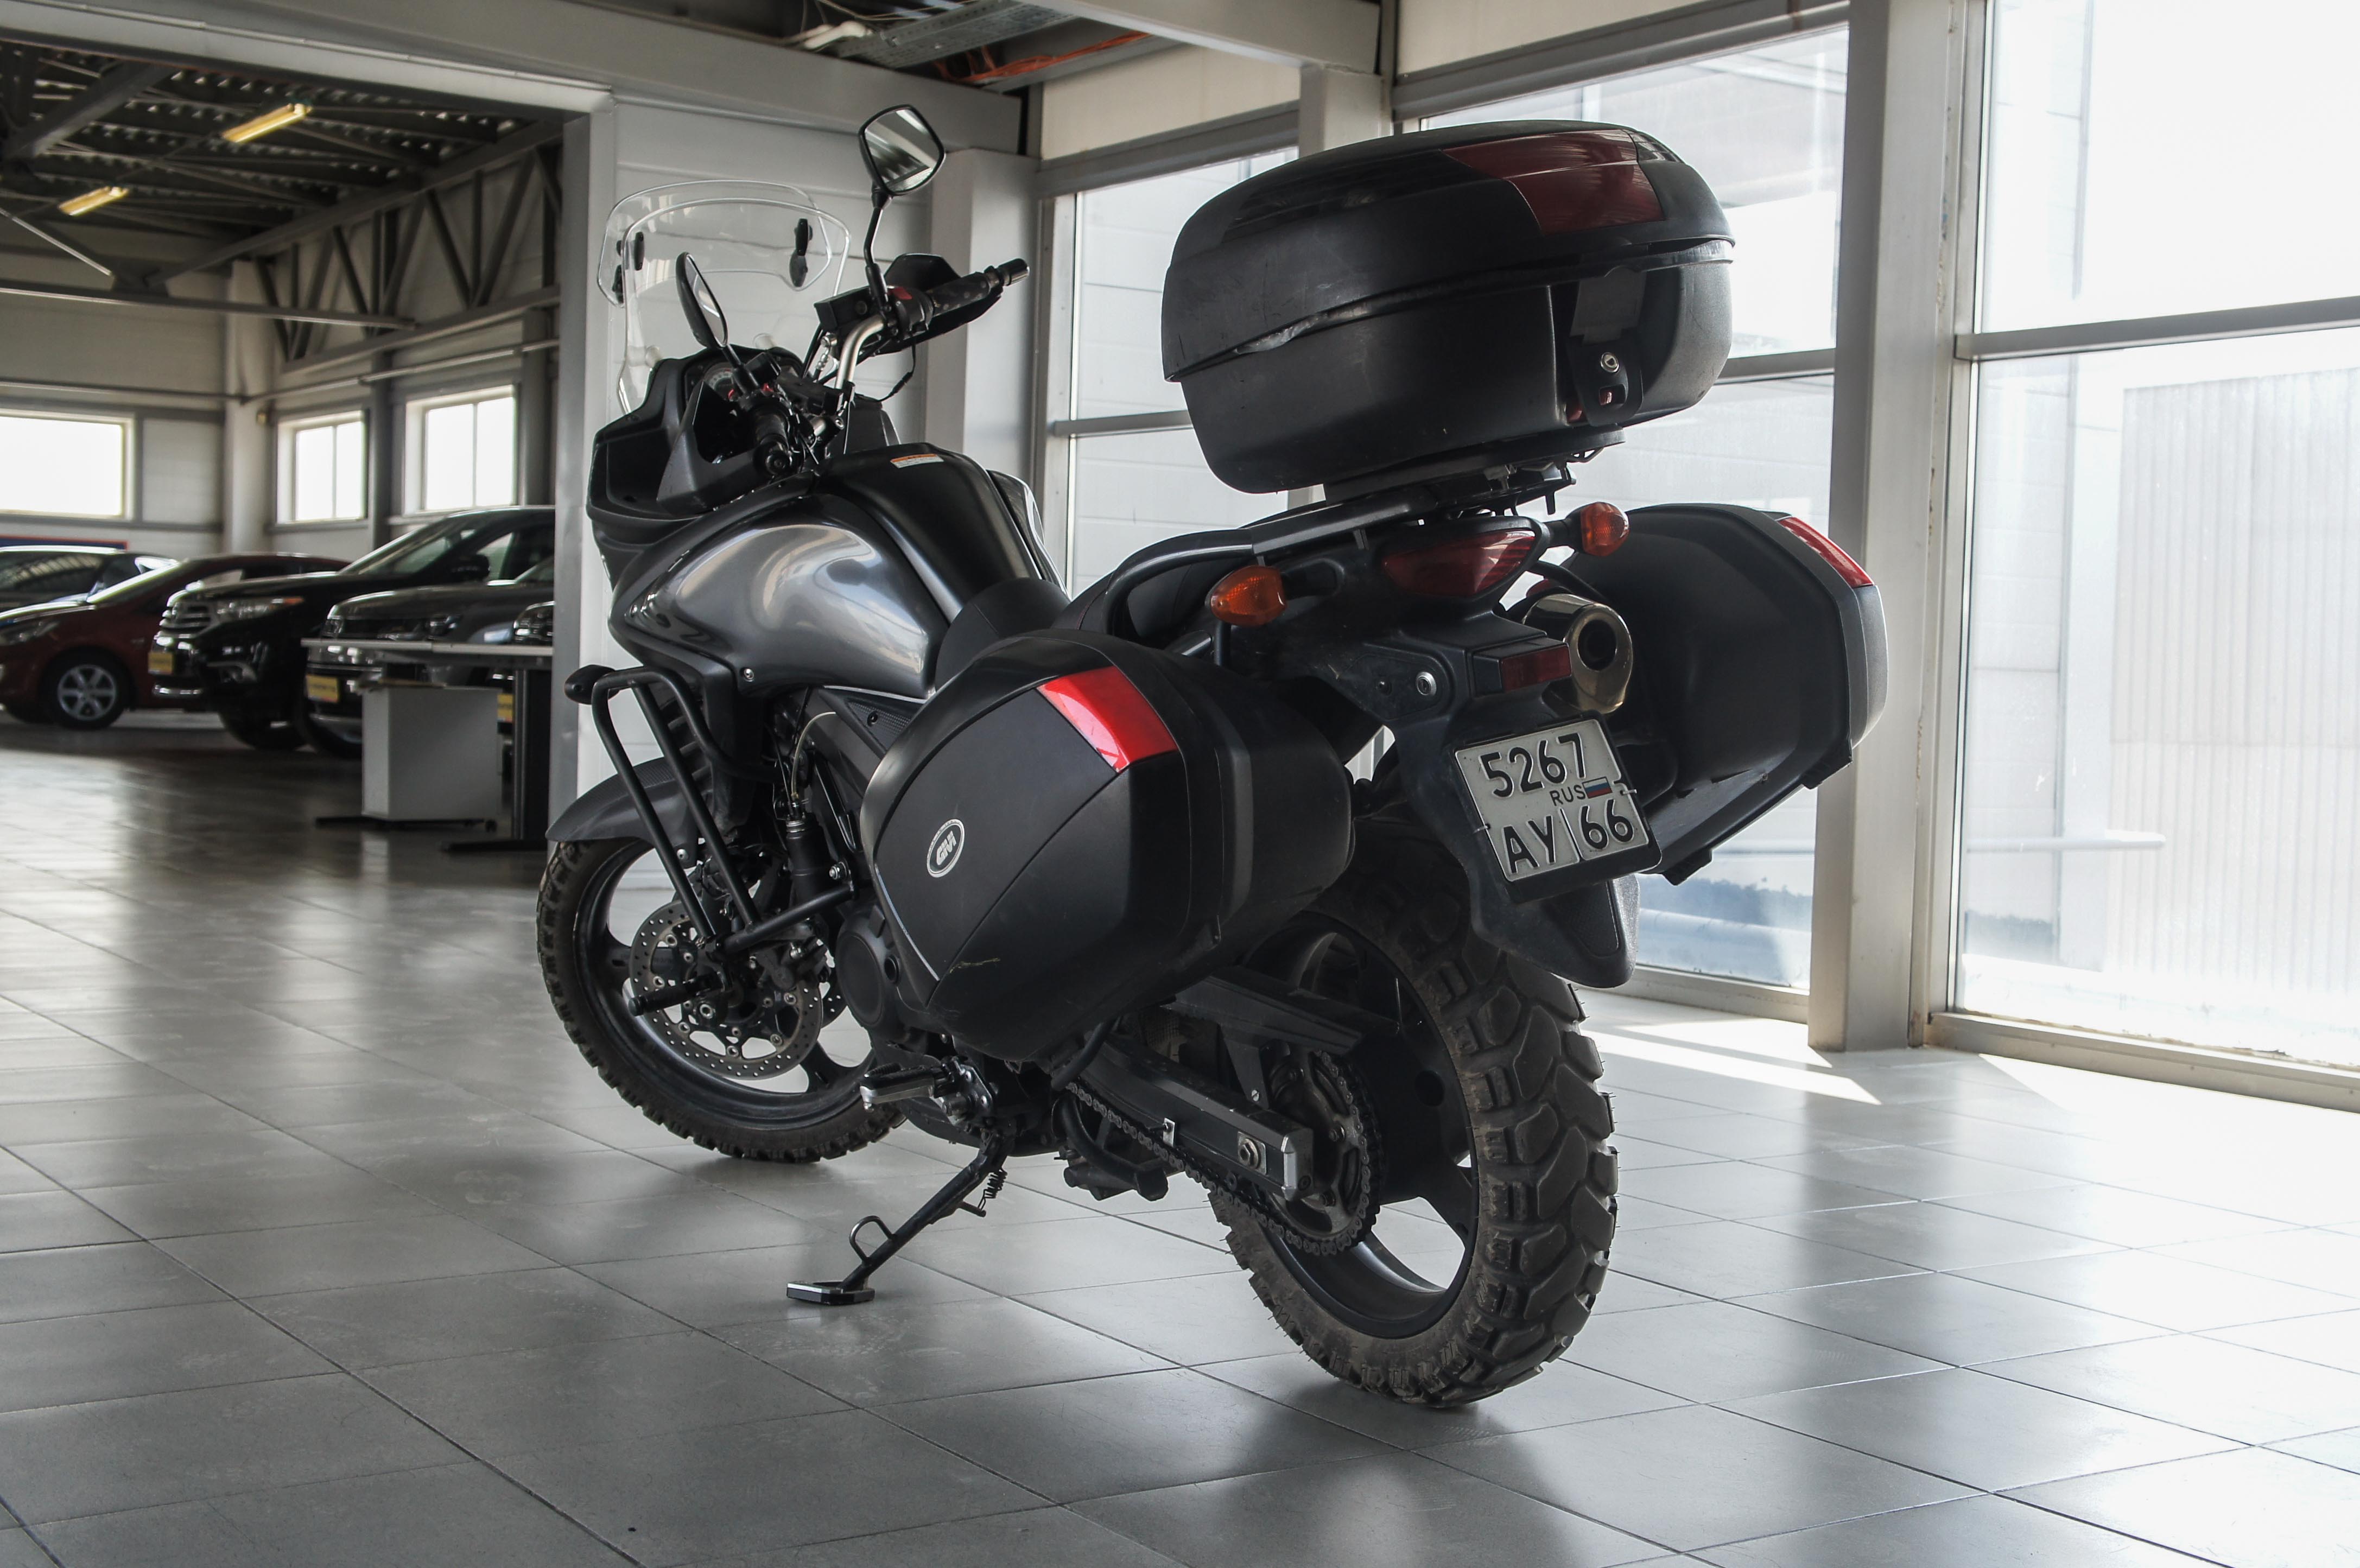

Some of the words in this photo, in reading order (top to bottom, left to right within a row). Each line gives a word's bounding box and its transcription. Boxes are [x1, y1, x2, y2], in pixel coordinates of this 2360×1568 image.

[1480, 733, 1585, 797] 5267
[1550, 786, 1586, 807] RUS
[1579, 799, 1634, 849] 66
[936, 830, 956, 865] GIVI
